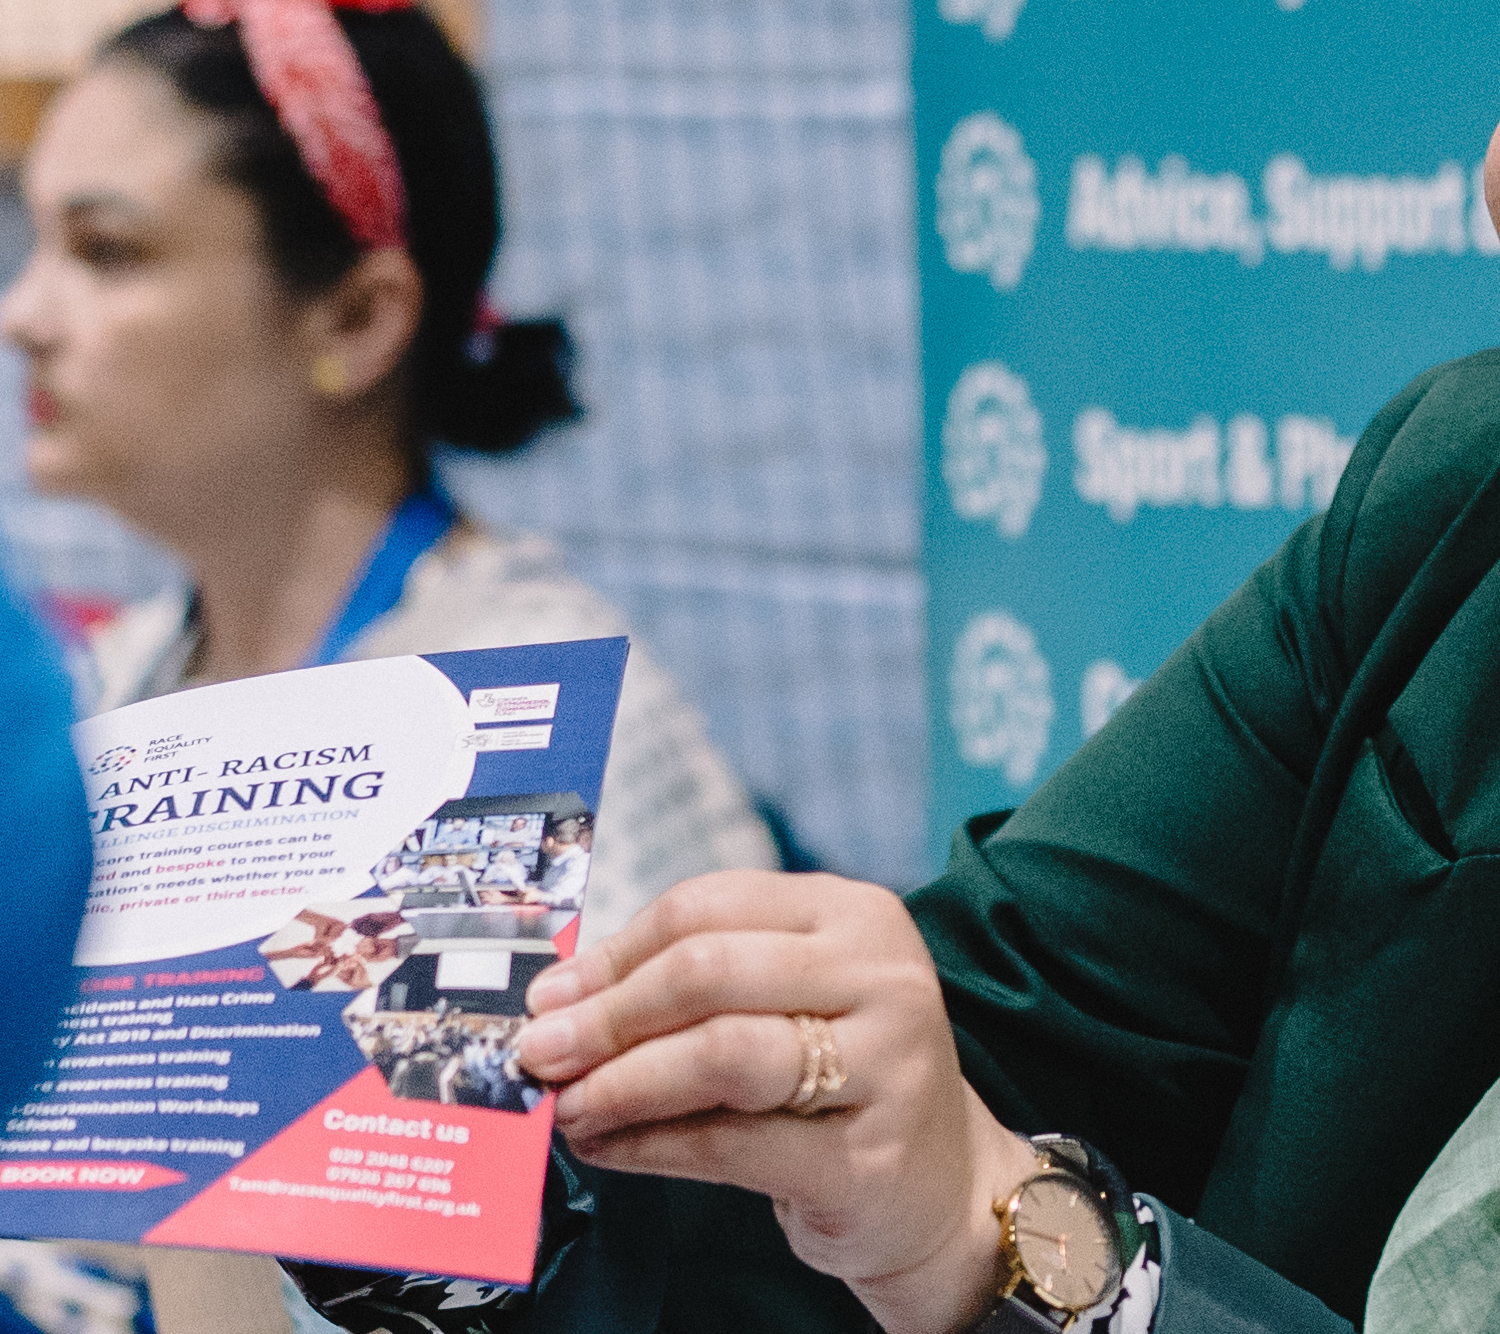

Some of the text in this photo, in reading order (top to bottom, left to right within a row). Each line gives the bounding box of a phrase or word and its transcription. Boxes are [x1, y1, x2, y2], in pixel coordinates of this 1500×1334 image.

[1263, 152, 1466, 272] Support
[1072, 404, 1222, 522] Sport
[1226, 413, 1275, 510] &
[147, 736, 213, 755] EQUALITY
[149, 734, 183, 746] RACE
[144, 750, 178, 763] FIRST
[96, 744, 374, 800] ANTI- RACISM
[100, 809, 360, 848] LLENGE DISCRIMINATION
[140, 839, 202, 860] training
[207, 836, 272, 853] courses
[278, 834, 307, 844] can
[312, 831, 332, 842] be
[120, 866, 151, 879] and
[156, 858, 226, 875] bespoke
[230, 856, 247, 866] to
[252, 852, 294, 865] meet
[299, 849, 335, 864] your
[156, 877, 205, 890] needs
[211, 869, 279, 884] whether
[284, 868, 314, 880] you
[319, 866, 346, 875] are
[120, 894, 186, 913] private
[189, 894, 203, 903] or
[207, 889, 246, 902] third
[142, 968, 265, 987] TRAINING
[137, 996, 174, 1011] and
[175, 993, 219, 1008] Hate
[220, 991, 275, 1005] Crime
[102, 1011, 174, 1027] training
[73, 1032, 106, 1047] Act
[108, 1029, 151, 1044] 2010
[151, 1027, 188, 1041] and
[189, 1023, 321, 1040] Discrimination
[57, 1052, 156, 1068] awareness
[157, 1050, 232, 1066] training
[56, 1077, 154, 1093] awareness
[154, 1075, 229, 1091] training
[157, 1100, 259, 1117] Workshops
[5, 1118, 77, 1133] Schools
[323, 1109, 470, 1144] Contact us
[52, 1137, 90, 1152] and
[90, 1137, 169, 1154] bespoke
[169, 1140, 245, 1158] training
[0, 1166, 146, 1184] BOOK NOW
